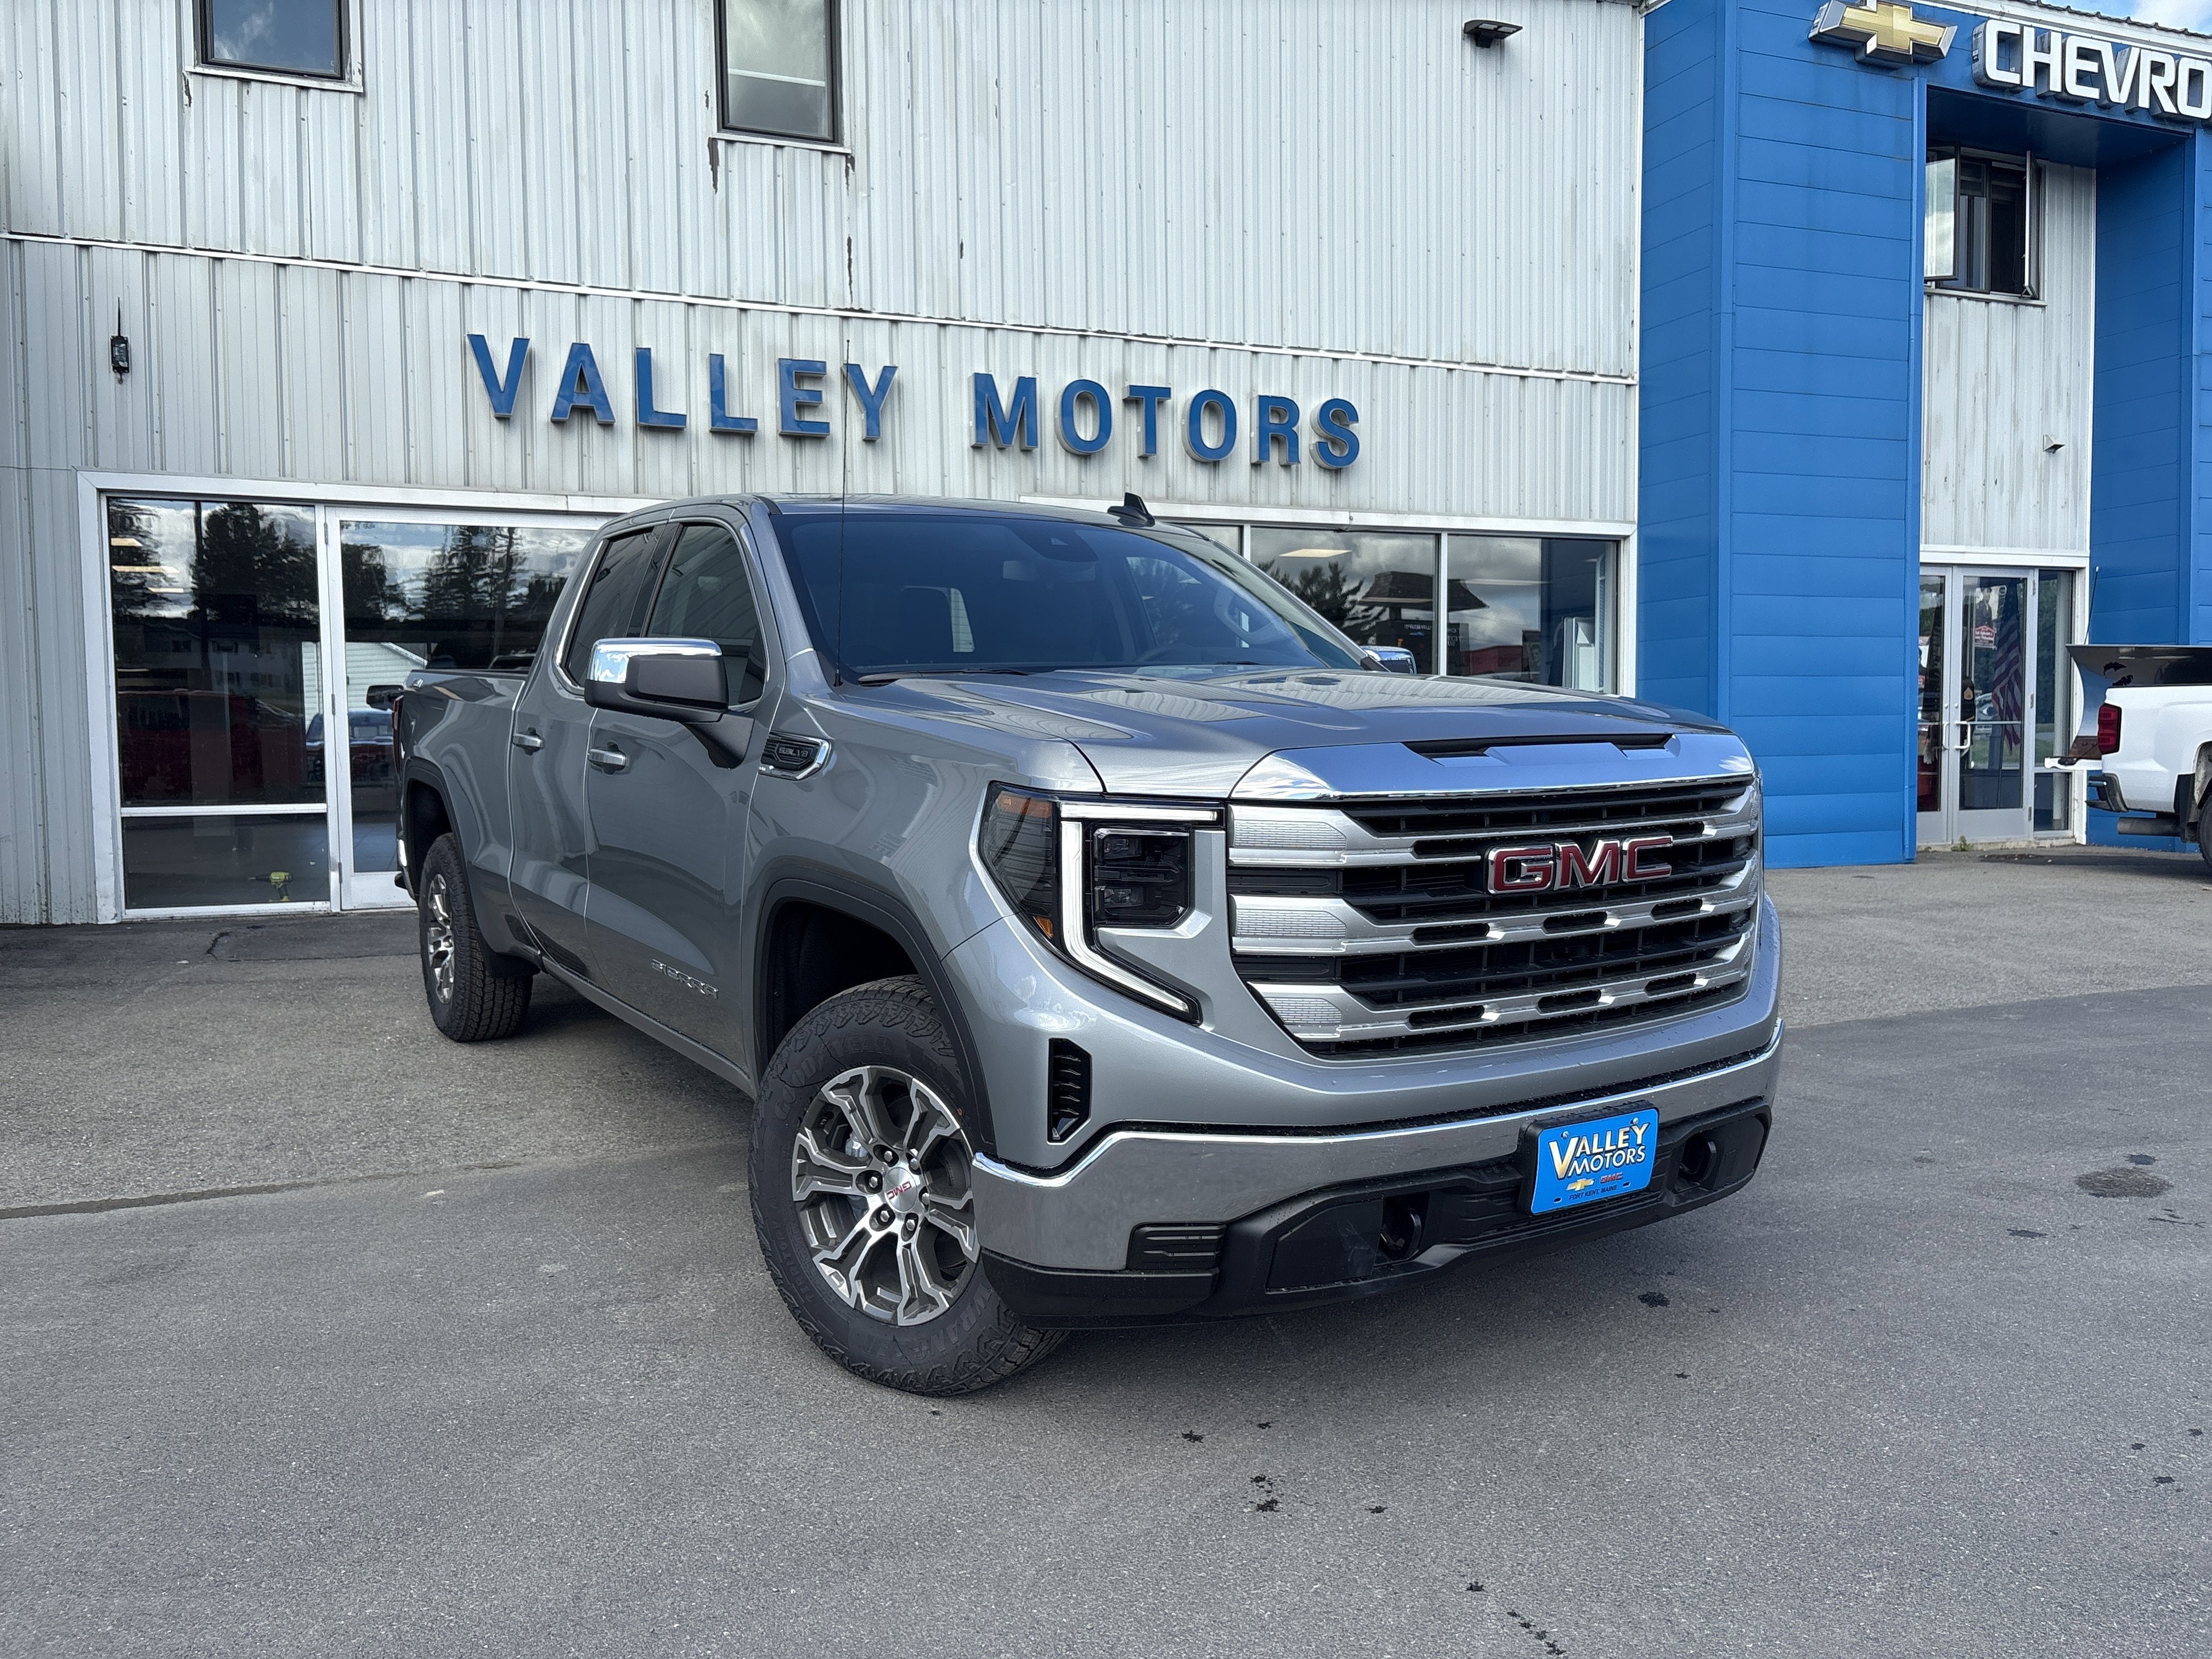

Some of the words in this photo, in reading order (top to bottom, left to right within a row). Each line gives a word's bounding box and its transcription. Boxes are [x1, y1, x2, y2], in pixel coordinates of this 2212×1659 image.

[1973, 19, 2212, 121] CHEVRO
[466, 332, 899, 442] VALLEY
[969, 371, 1361, 470] MOTORS
[1487, 835, 1674, 895] GMC
[1548, 1121, 1651, 1180] VALLEY
[1567, 1144, 1647, 1177] MOTORS
[886, 1180, 912, 1200] GMC
[1568, 1192, 1584, 1200] FORT
[1600, 1184, 1619, 1194] MAINE
[1599, 1171, 1624, 1184] GMC
